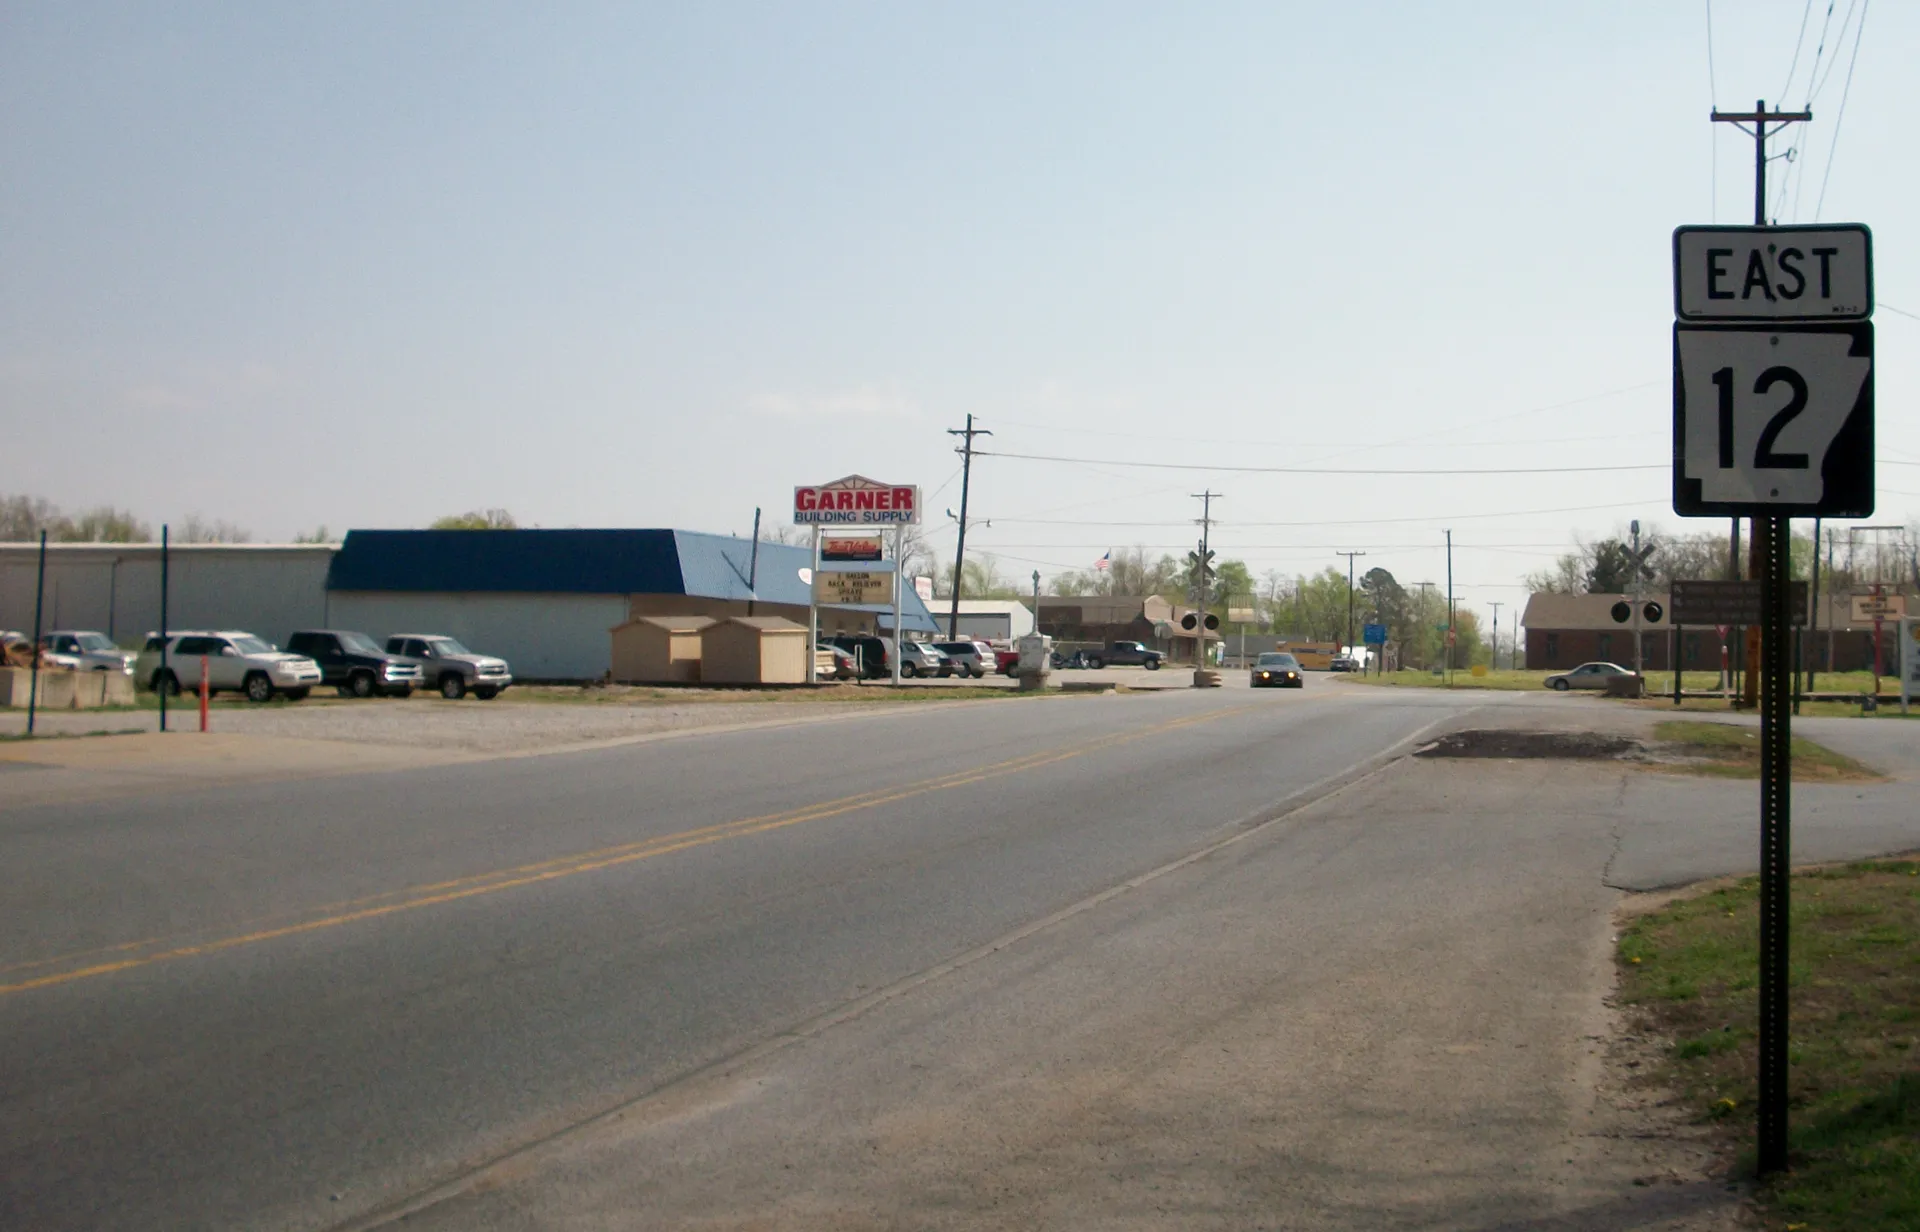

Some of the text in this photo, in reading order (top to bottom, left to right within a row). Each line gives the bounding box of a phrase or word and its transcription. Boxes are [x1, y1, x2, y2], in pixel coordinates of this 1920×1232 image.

[1706, 247, 1838, 301] EAST
[1711, 365, 1809, 469] 12
[795, 511, 913, 523] BUILDING SUPPLY
[796, 488, 913, 511] GARNER
